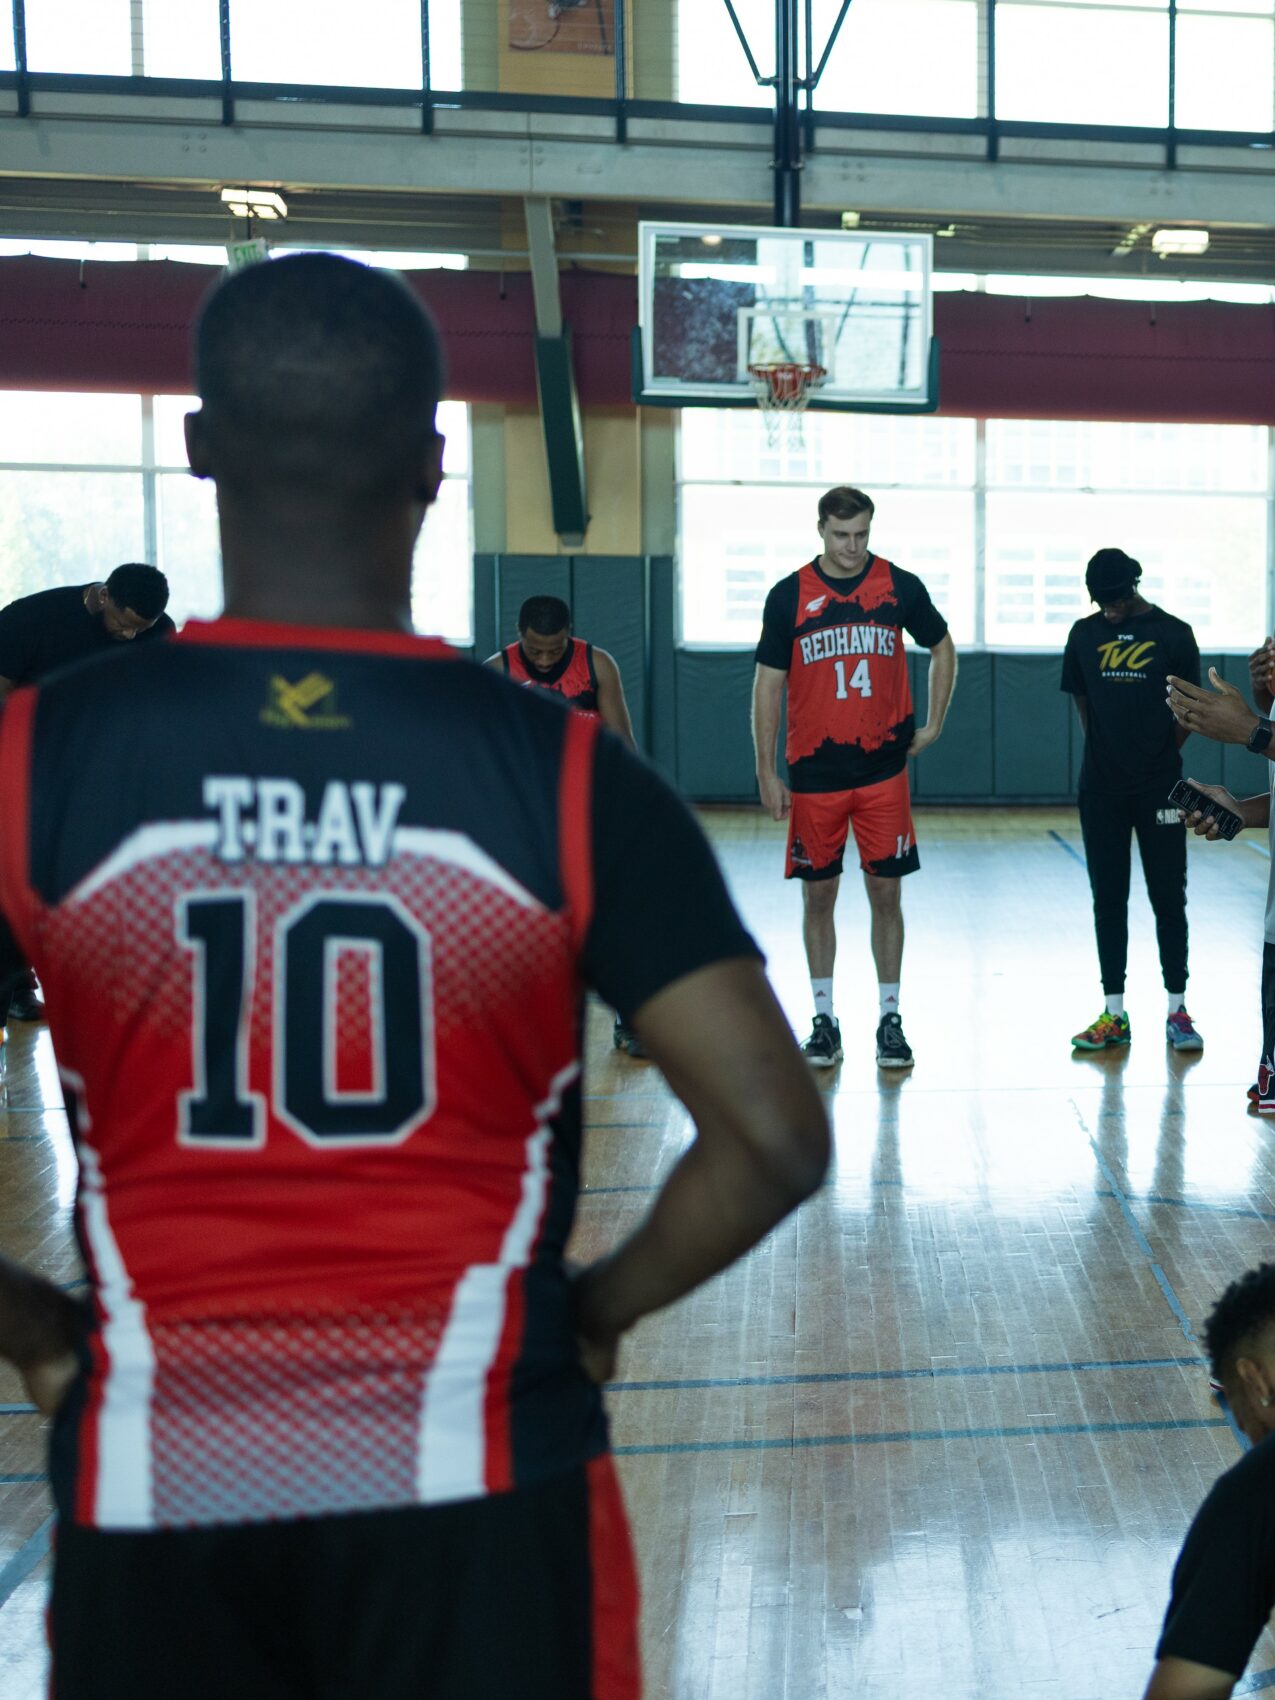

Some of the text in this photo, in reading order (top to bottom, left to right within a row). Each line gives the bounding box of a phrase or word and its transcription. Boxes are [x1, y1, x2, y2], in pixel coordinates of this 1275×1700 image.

[800, 625, 896, 665] REDHAWKS
[1097, 640, 1156, 670] TVC
[834, 658, 872, 699] 14
[202, 776, 405, 866] TRAV
[174, 890, 437, 1150] 10
